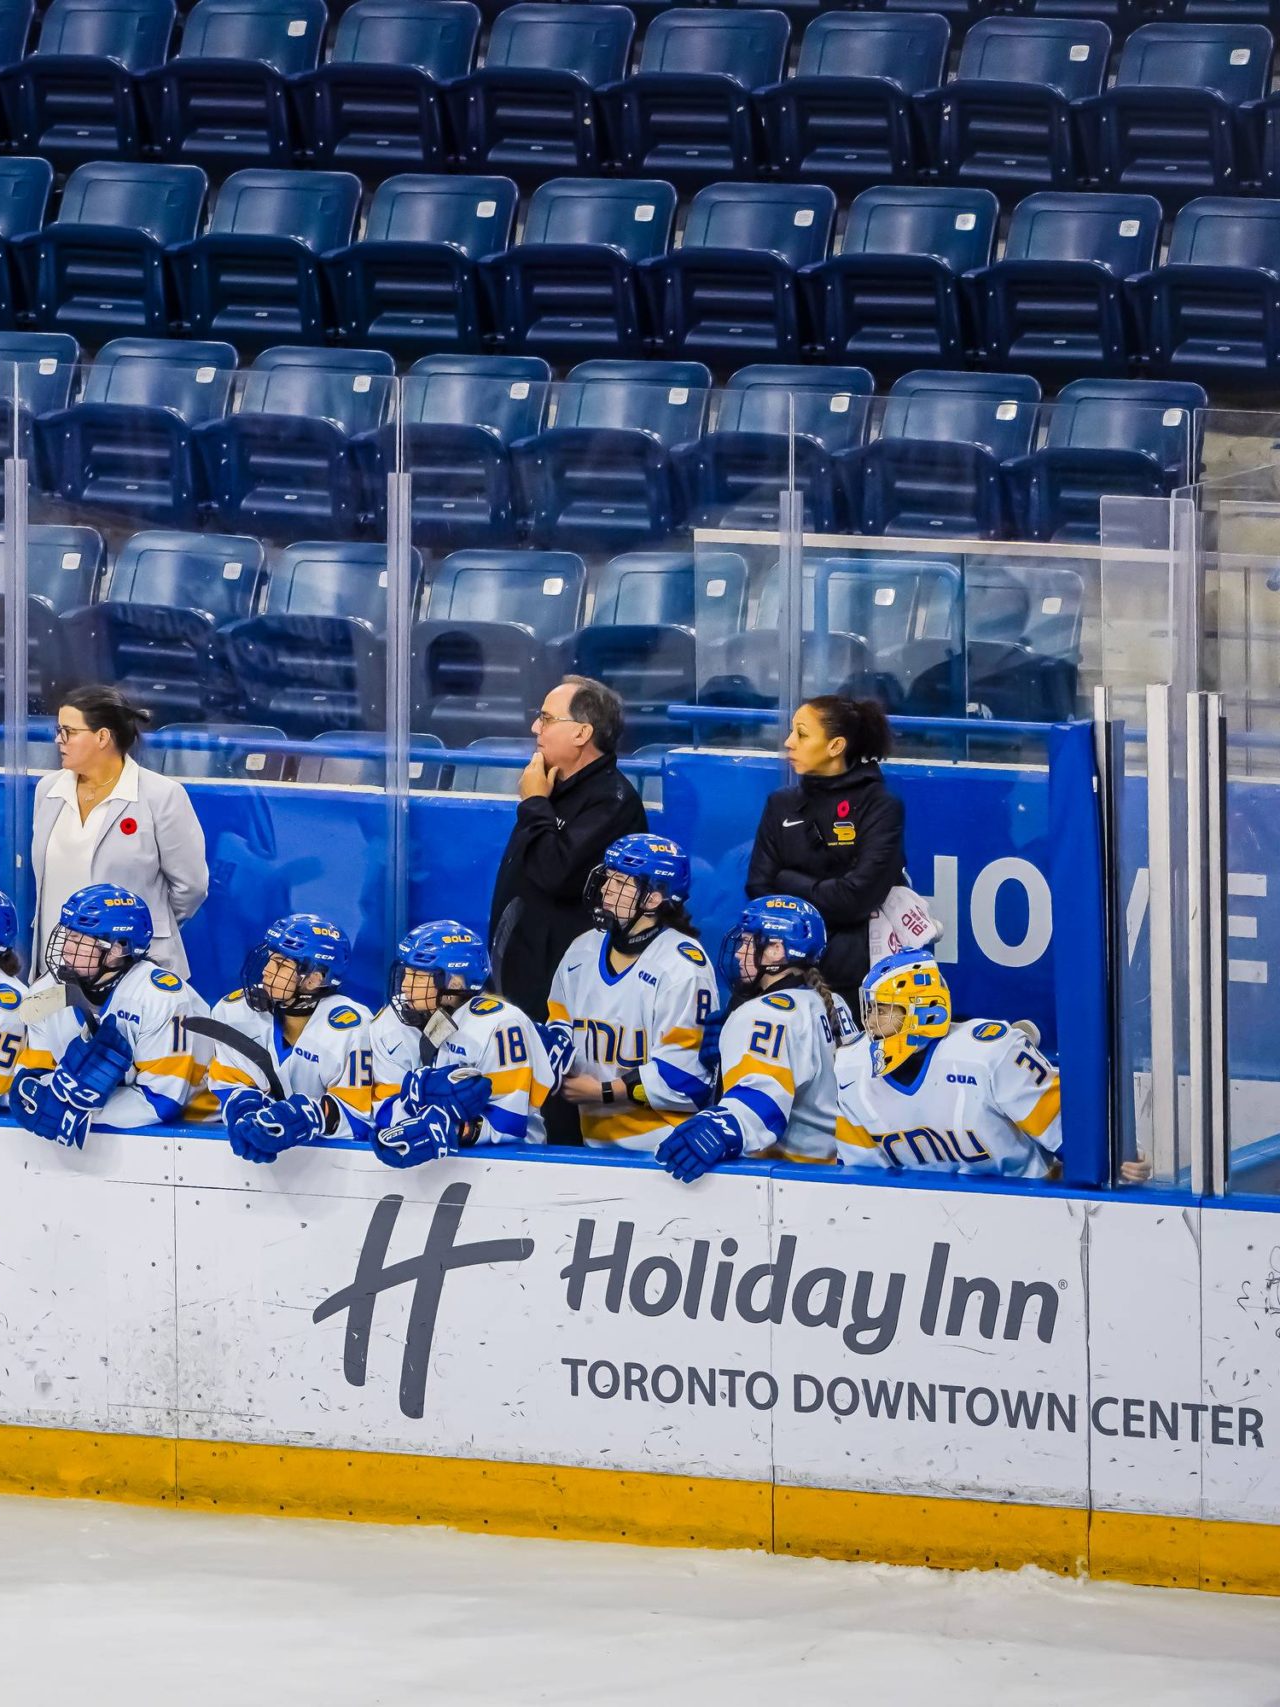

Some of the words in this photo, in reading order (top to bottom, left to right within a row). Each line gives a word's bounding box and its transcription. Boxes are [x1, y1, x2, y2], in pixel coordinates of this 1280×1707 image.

[695, 988, 711, 1024] 8
[172, 1015, 187, 1053] 11
[495, 1026, 527, 1067] 18
[749, 1020, 787, 1059] 21
[295, 1047, 320, 1064] OUA
[348, 1049, 373, 1087] 15
[945, 1073, 978, 1086] OUA
[560, 1218, 906, 1355] Holiday
[560, 1357, 779, 1411] TORONTO
[793, 1373, 1077, 1433] DOWNTOWN
[1091, 1396, 1265, 1449] CENTER
